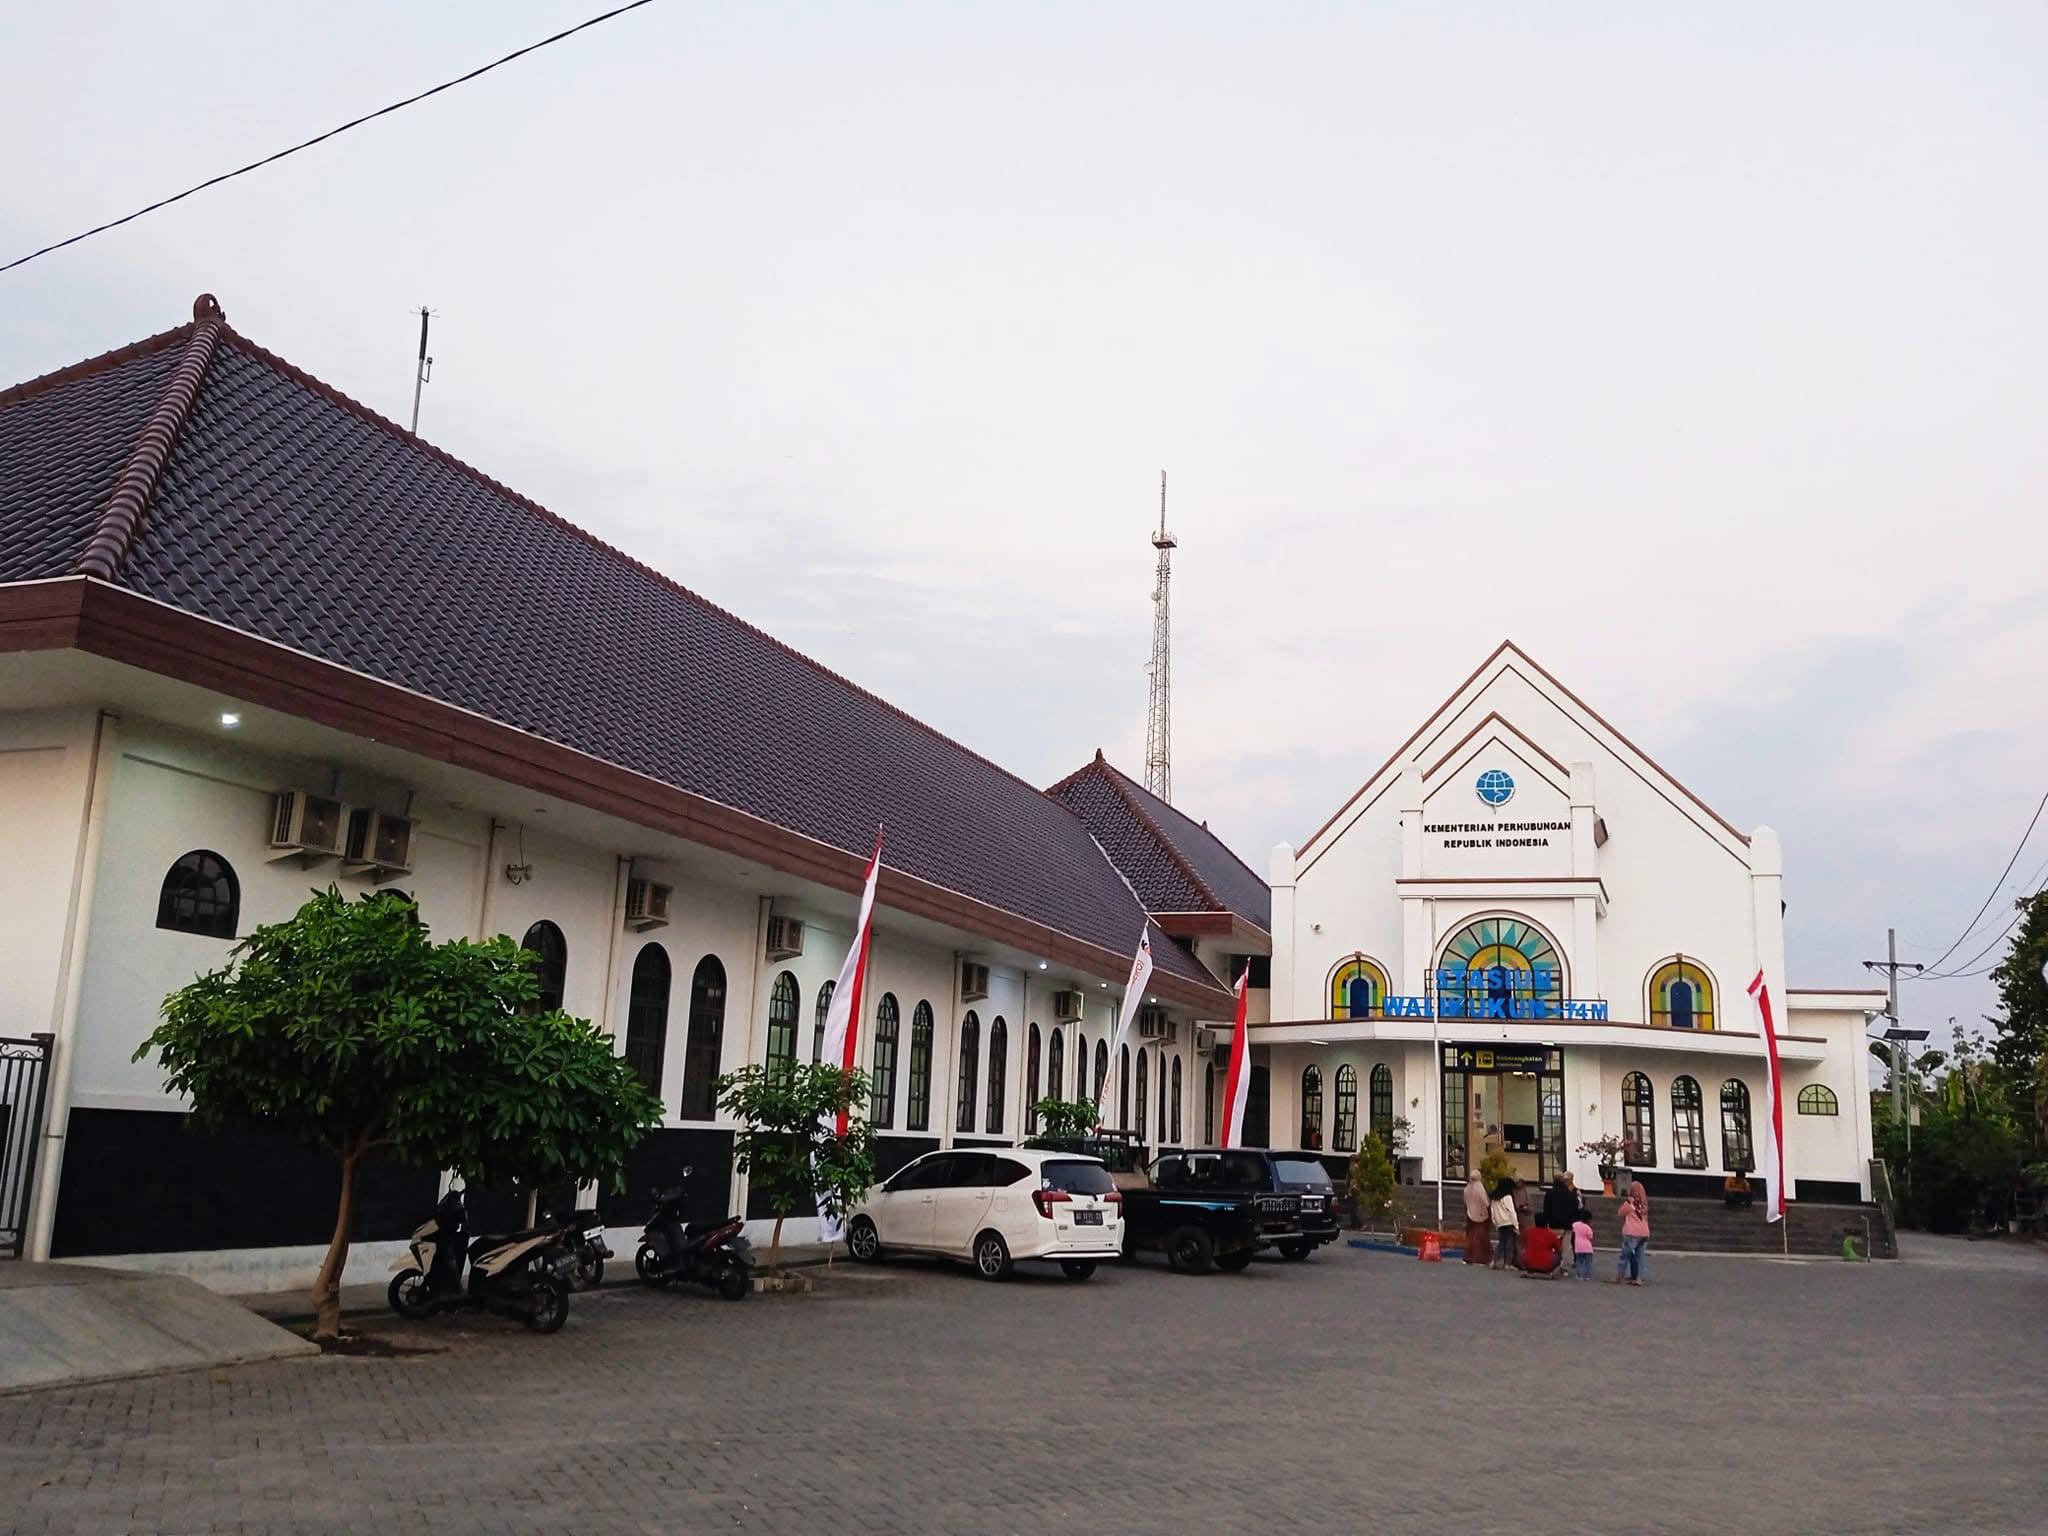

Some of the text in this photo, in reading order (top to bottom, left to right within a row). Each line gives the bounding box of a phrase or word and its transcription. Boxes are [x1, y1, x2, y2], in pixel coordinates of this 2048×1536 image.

[1424, 821, 1571, 833] KEMENTERIAN PERHUBUNGAN
[1443, 838, 1549, 849] REPUBLIK INDONESIA
[1436, 968, 1553, 991] STASIUN
[1382, 996, 1546, 1020] WALIKUKUN
